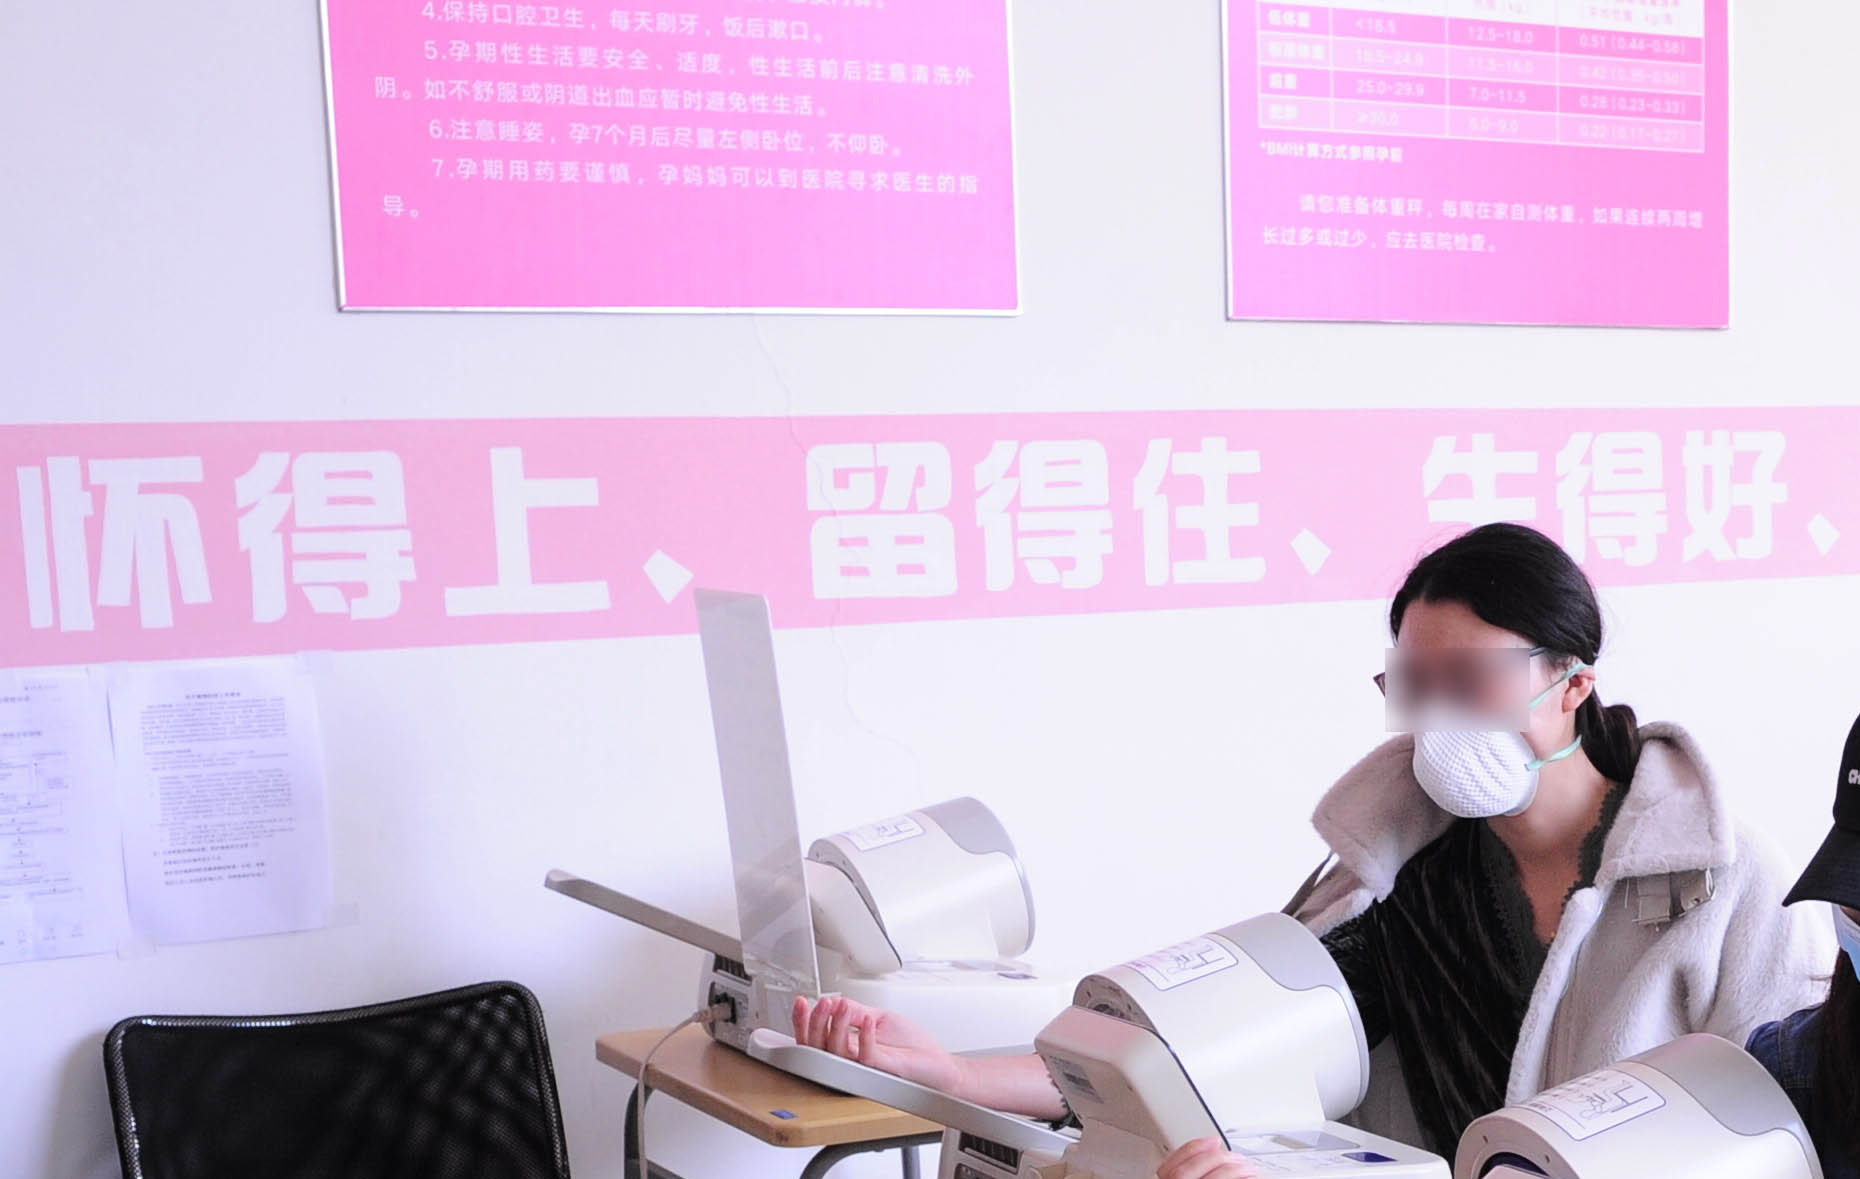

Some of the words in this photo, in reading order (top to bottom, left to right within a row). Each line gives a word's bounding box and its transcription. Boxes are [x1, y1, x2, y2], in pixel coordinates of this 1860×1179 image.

[421, 1, 824, 44] 4.保持口腔卫生，每天刷牙，饭后漱口。
[424, 39, 974, 87] 5.孕期性生活要安全、适度，性生活前后注意清洗外
[374, 75, 828, 117] 阴。如不舒服或阴道出血应暂时避免性生活。
[428, 119, 901, 157] 6.注意睡姿，孕7个月后尽量左侧卧位，不仰卧。
[431, 158, 979, 194] 7.孕期用药要谨慎，孕妈妈可以到医院寻求医生的指
[383, 194, 420, 219] 导。
[1262, 225, 1497, 253] 长过多或过少，应去医院检查。
